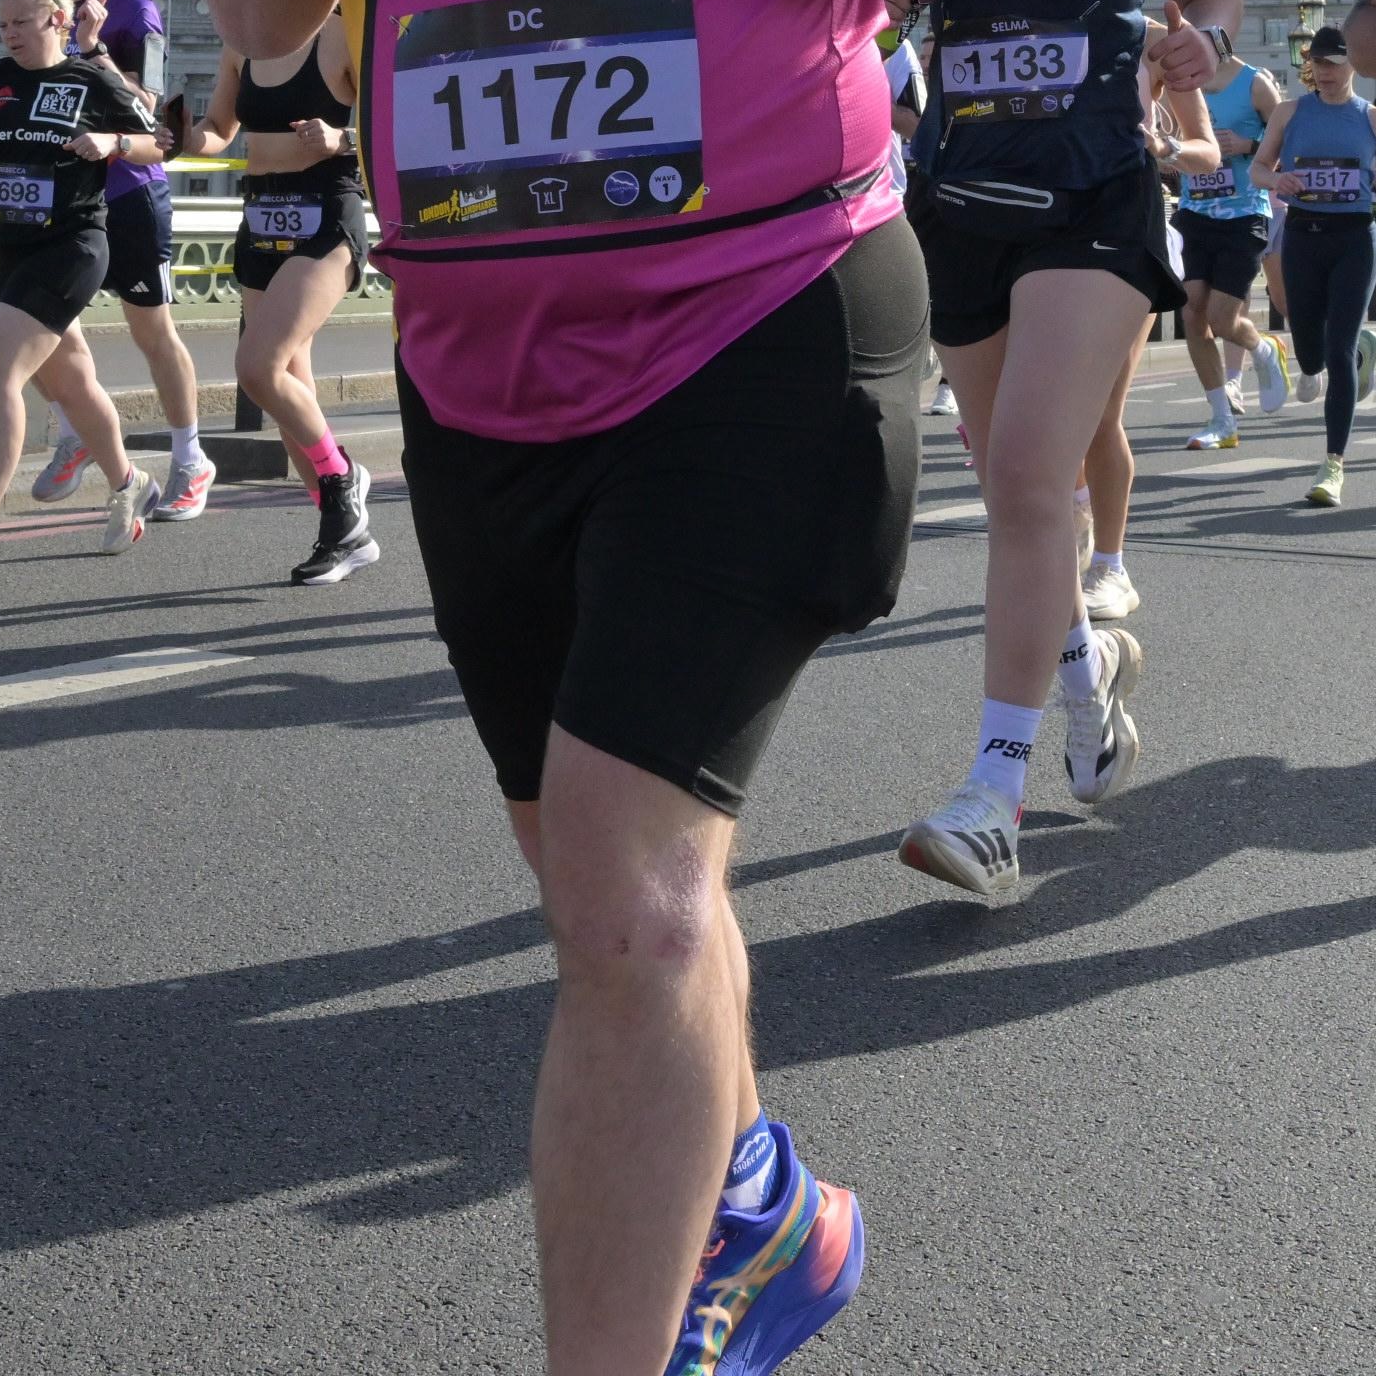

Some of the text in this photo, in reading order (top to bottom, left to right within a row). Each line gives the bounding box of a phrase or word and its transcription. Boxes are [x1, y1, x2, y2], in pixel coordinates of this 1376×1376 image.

[508, 8, 544, 32] DC
[991, 19, 1030, 33] SELMA
[963, 44, 1066, 85] 1133
[40, 100, 75, 113] BELT
[44, 93, 77, 103] BELOW
[434, 55, 654, 151] 1172
[15, 128, 73, 145] Comfort
[654, 174, 677, 183] WAVE
[1192, 171, 1226, 187] 1550
[1305, 171, 1351, 188] 1517
[662, 183, 669, 196] 1
[543, 192, 556, 205] XL
[260, 210, 302, 232] 793
[1059, 642, 1088, 664] RC
[983, 738, 1032, 764] PSR
[732, 1138, 769, 1176] MORE MIL
